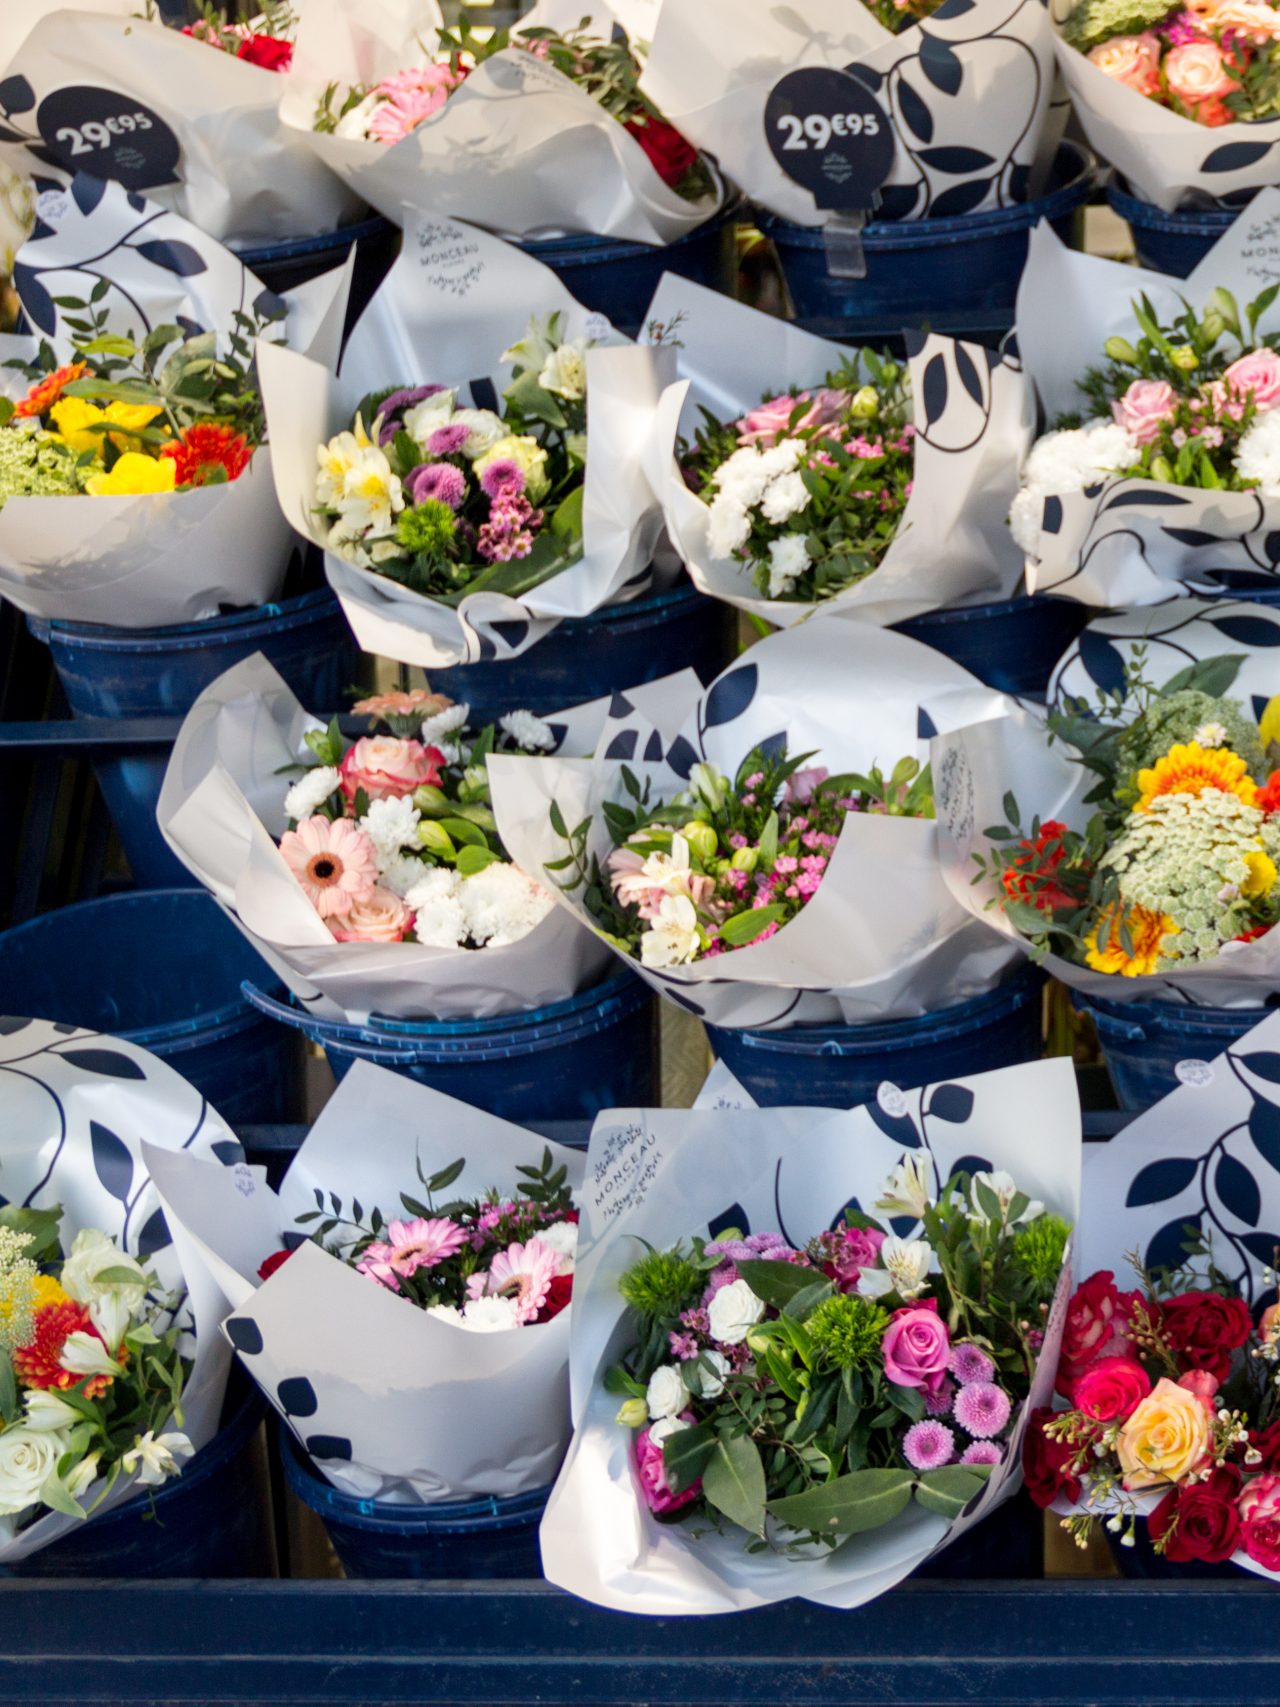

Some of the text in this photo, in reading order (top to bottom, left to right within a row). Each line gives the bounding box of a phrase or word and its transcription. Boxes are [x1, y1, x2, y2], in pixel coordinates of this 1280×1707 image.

[56, 112, 153, 156] 29€95
[777, 113, 879, 150] 29€95
[420, 244, 479, 267] MONCEAU
[595, 1133, 656, 1206] MONCEAU
